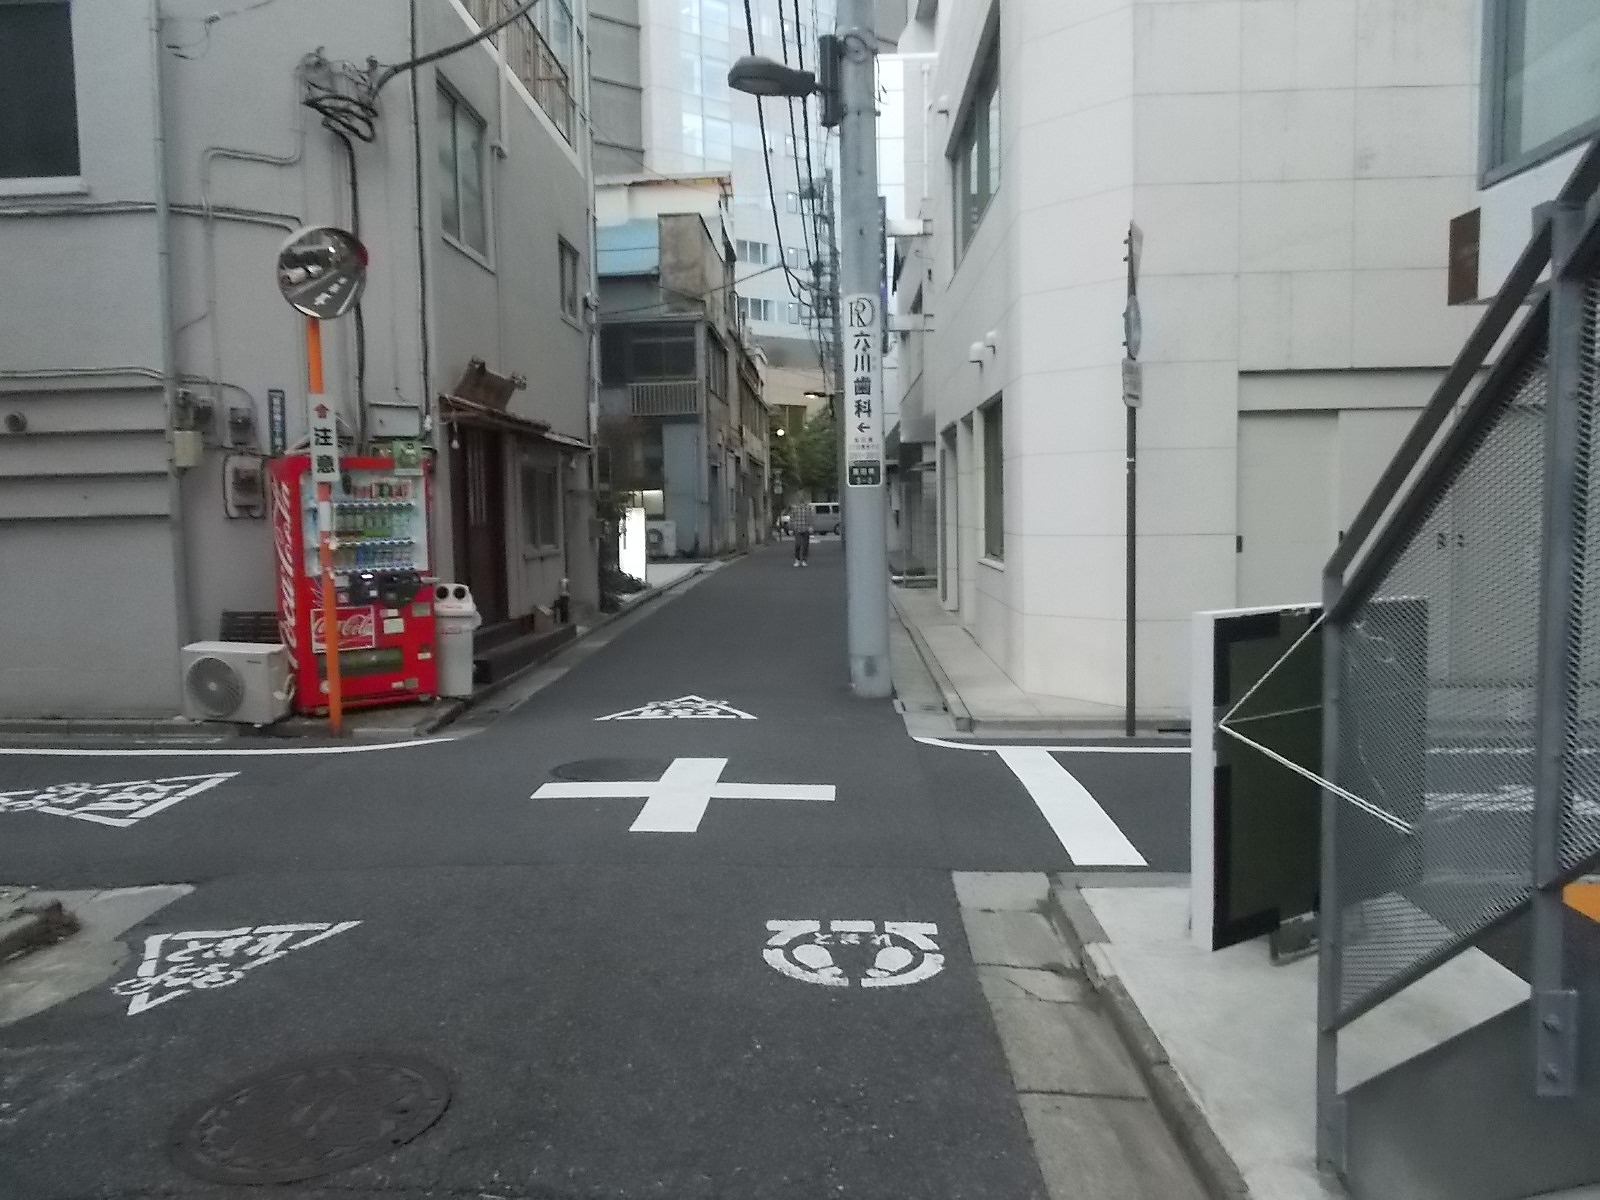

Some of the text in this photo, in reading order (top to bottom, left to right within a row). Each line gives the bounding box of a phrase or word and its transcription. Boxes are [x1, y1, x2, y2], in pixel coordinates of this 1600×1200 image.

[853, 331, 872, 419] 六川歯科
[313, 427, 335, 474] 注意
